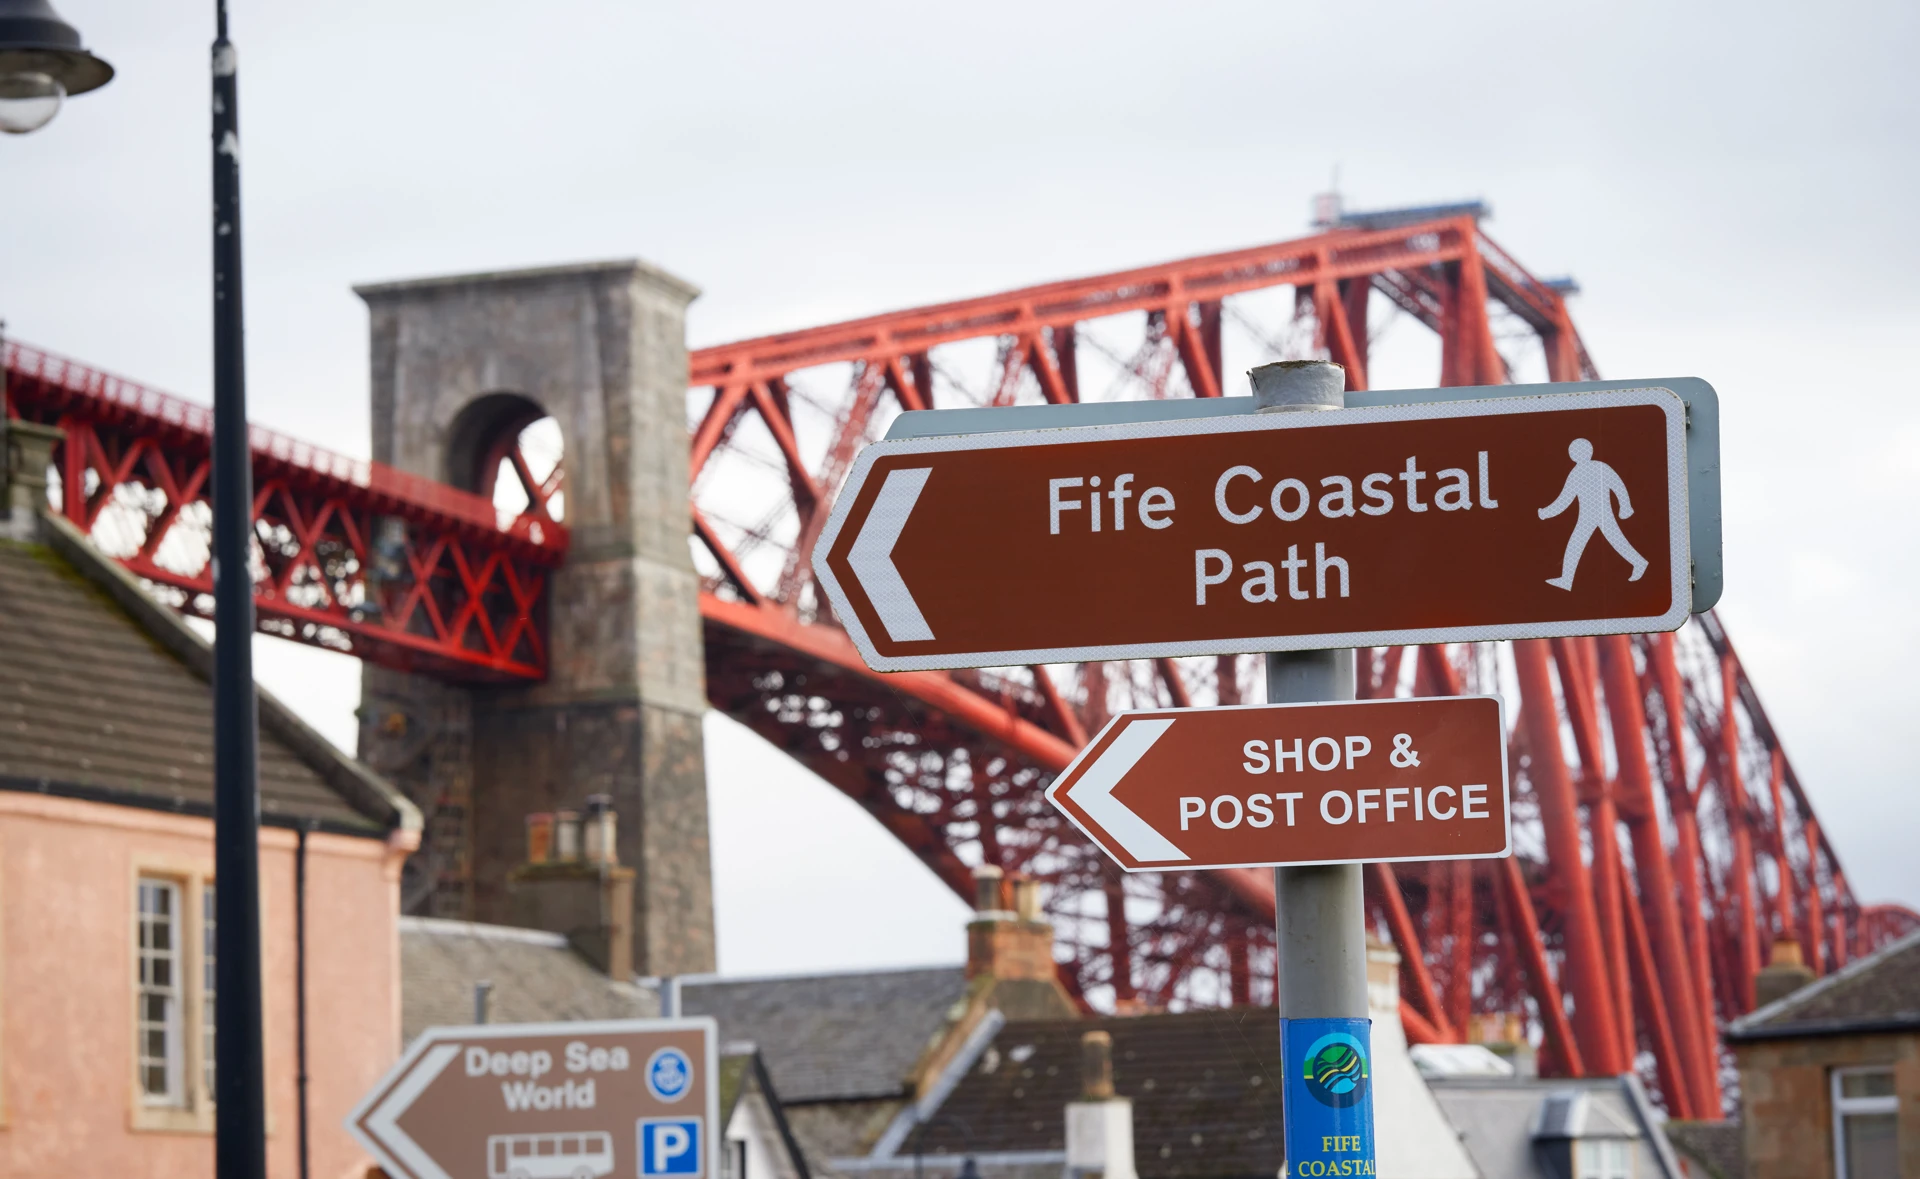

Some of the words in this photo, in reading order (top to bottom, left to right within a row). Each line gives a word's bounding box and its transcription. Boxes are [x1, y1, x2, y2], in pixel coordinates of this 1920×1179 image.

[1049, 473, 1176, 535] Fife
[1215, 451, 1499, 523] Coastal
[1195, 543, 1350, 605] Path
[1243, 735, 1372, 776] SHOP
[1390, 733, 1421, 769] &
[1178, 791, 1304, 831] POST
[1319, 783, 1490, 826] OFFICE
[465, 1046, 552, 1077] Deep
[565, 1041, 629, 1073] Sea
[502, 1079, 596, 1112] World
[653, 1125, 690, 1173] P
[1321, 1135, 1361, 1152] FIFE
[1298, 1159, 1376, 1177] COASTAL
